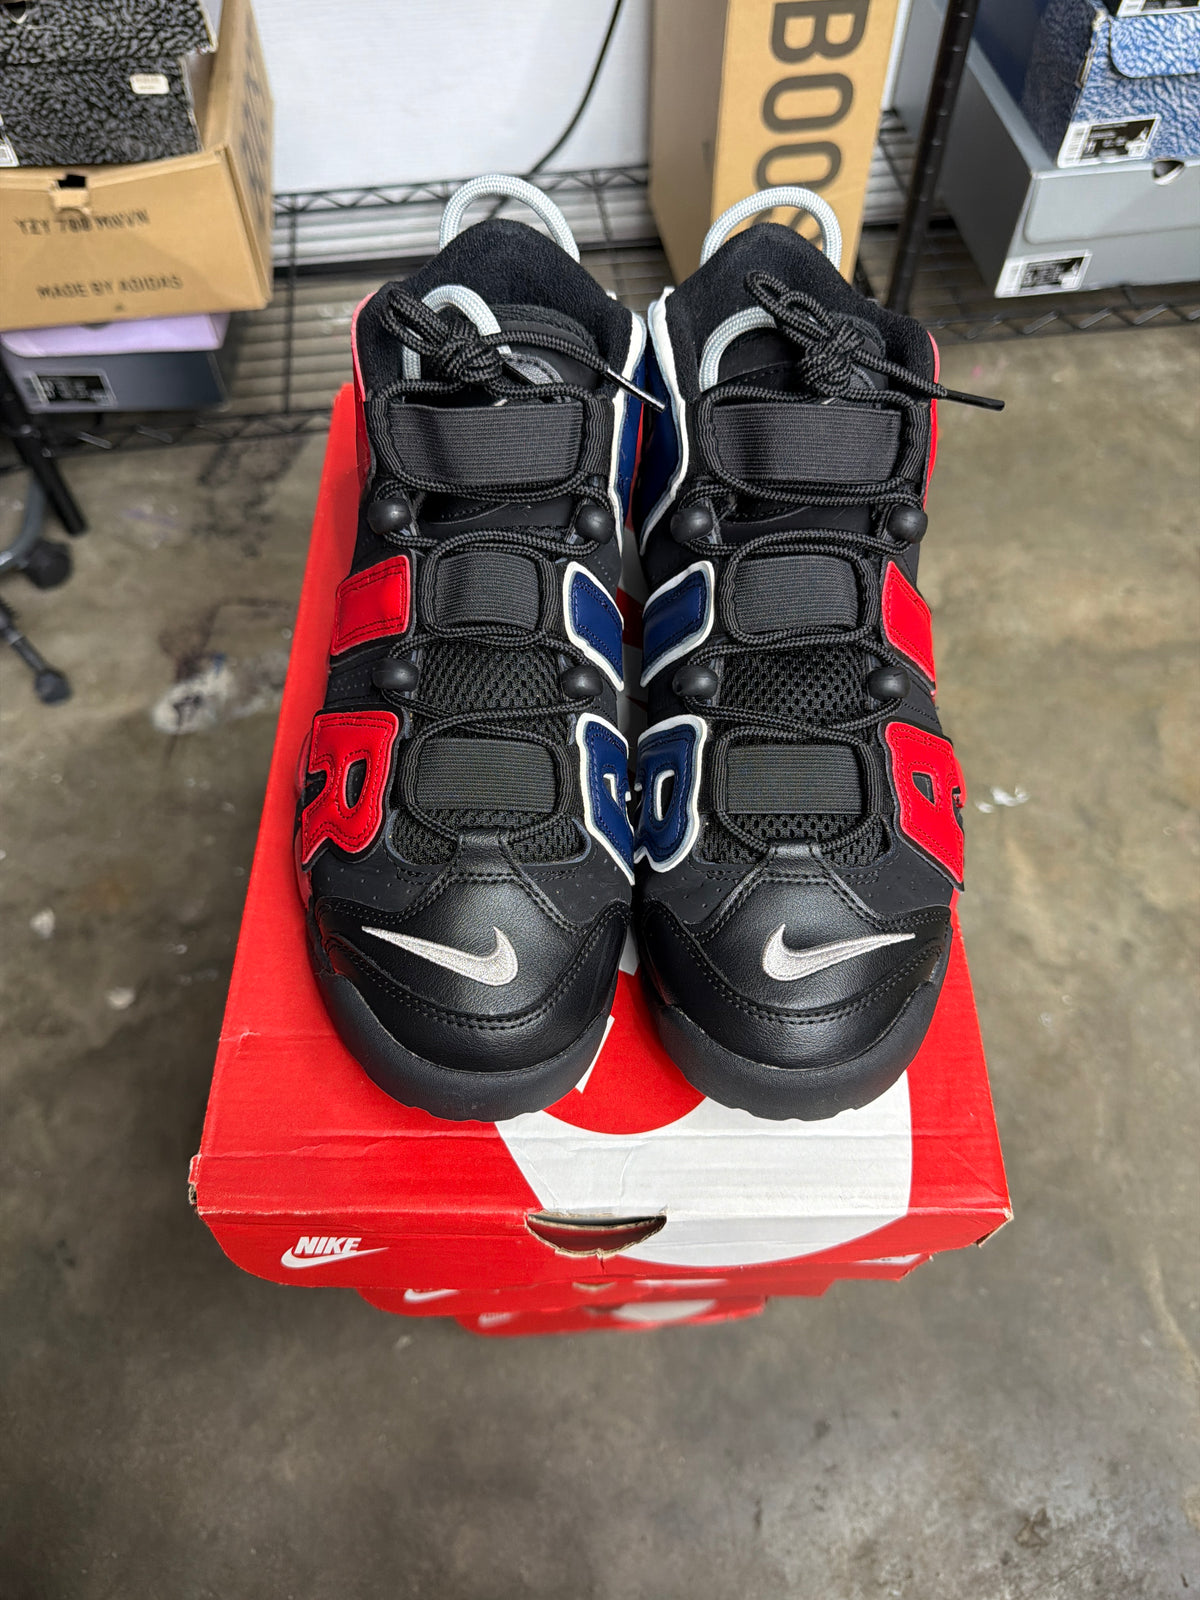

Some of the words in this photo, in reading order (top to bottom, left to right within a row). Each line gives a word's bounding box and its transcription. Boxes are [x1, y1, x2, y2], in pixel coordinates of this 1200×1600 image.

[36, 282, 88, 300] MADE
[90, 280, 113, 296] BY
[118, 273, 183, 293] ADIDAS
[295, 1236, 363, 1255] NIKE
